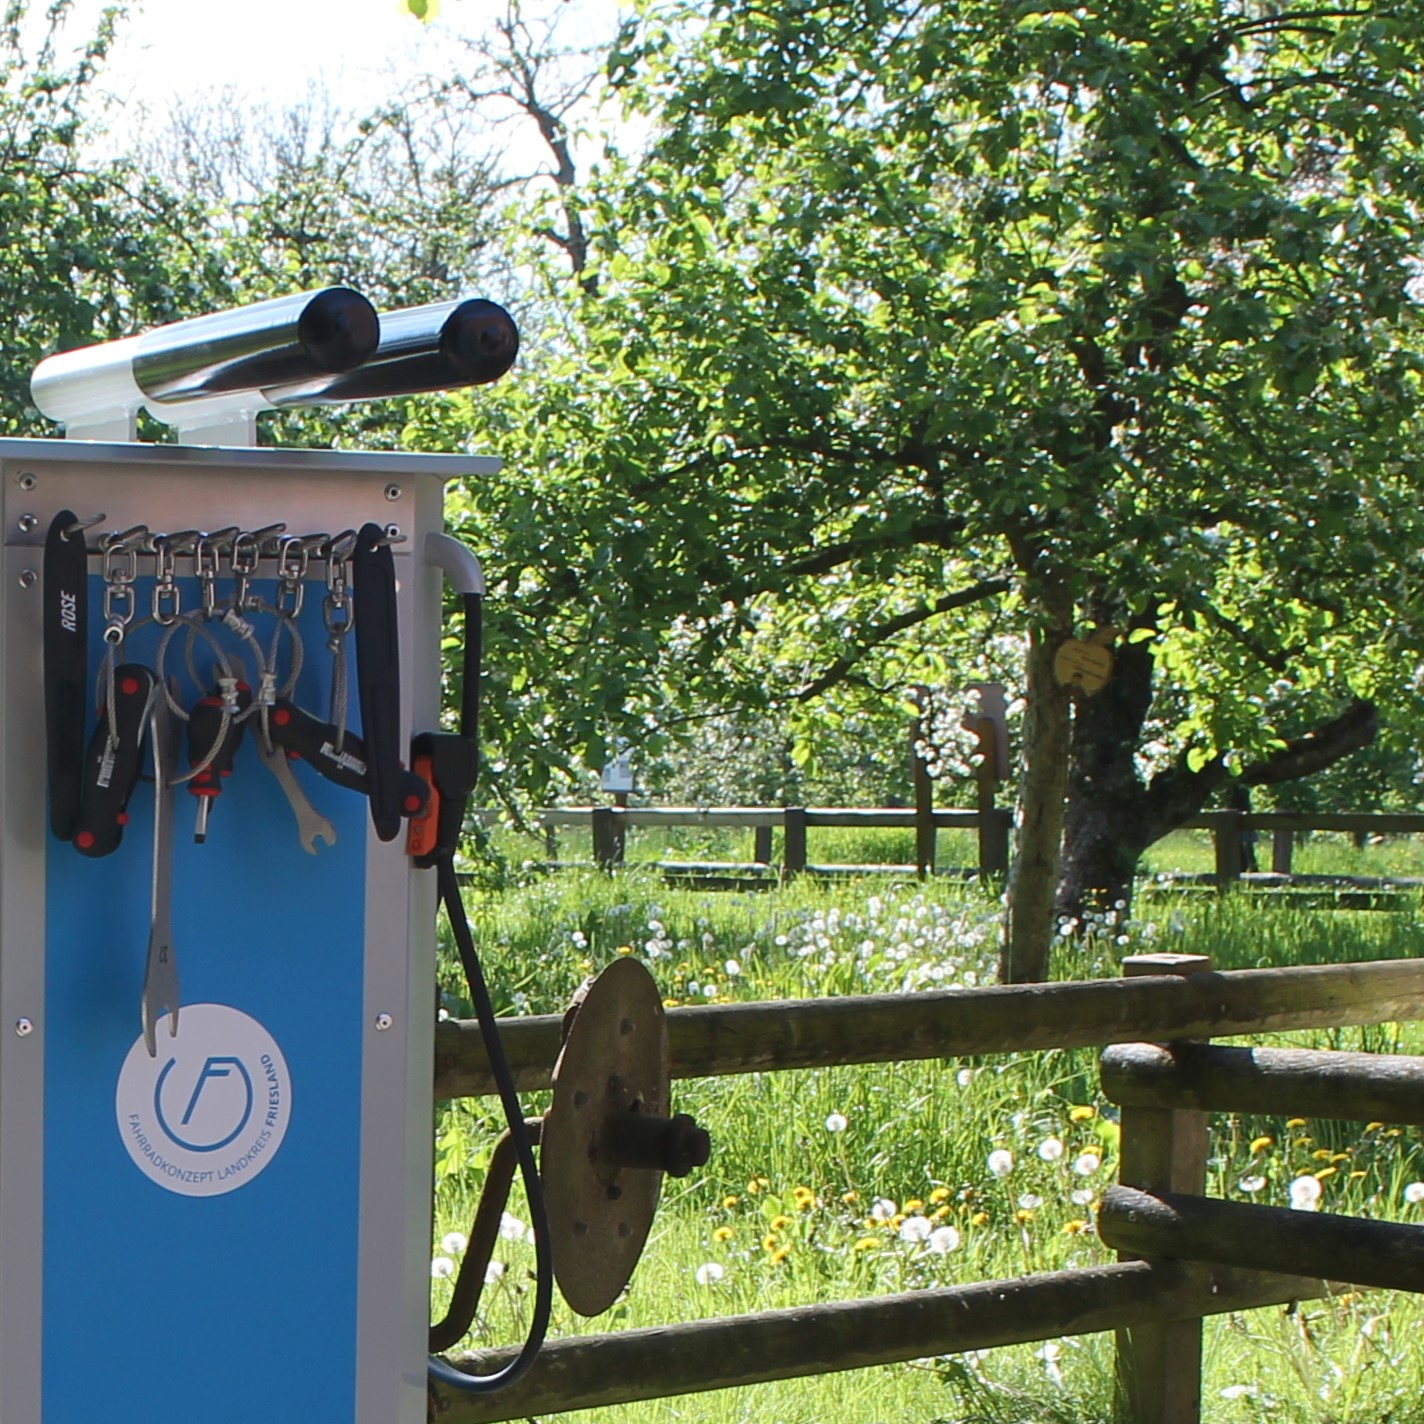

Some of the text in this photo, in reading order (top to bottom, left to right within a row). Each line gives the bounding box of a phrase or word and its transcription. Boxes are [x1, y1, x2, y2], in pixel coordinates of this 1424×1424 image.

[60, 589, 76, 632] ROSE
[129, 1054, 280, 1183] FAHRRADKONZEPT LANDKREIS FRIESLAND
